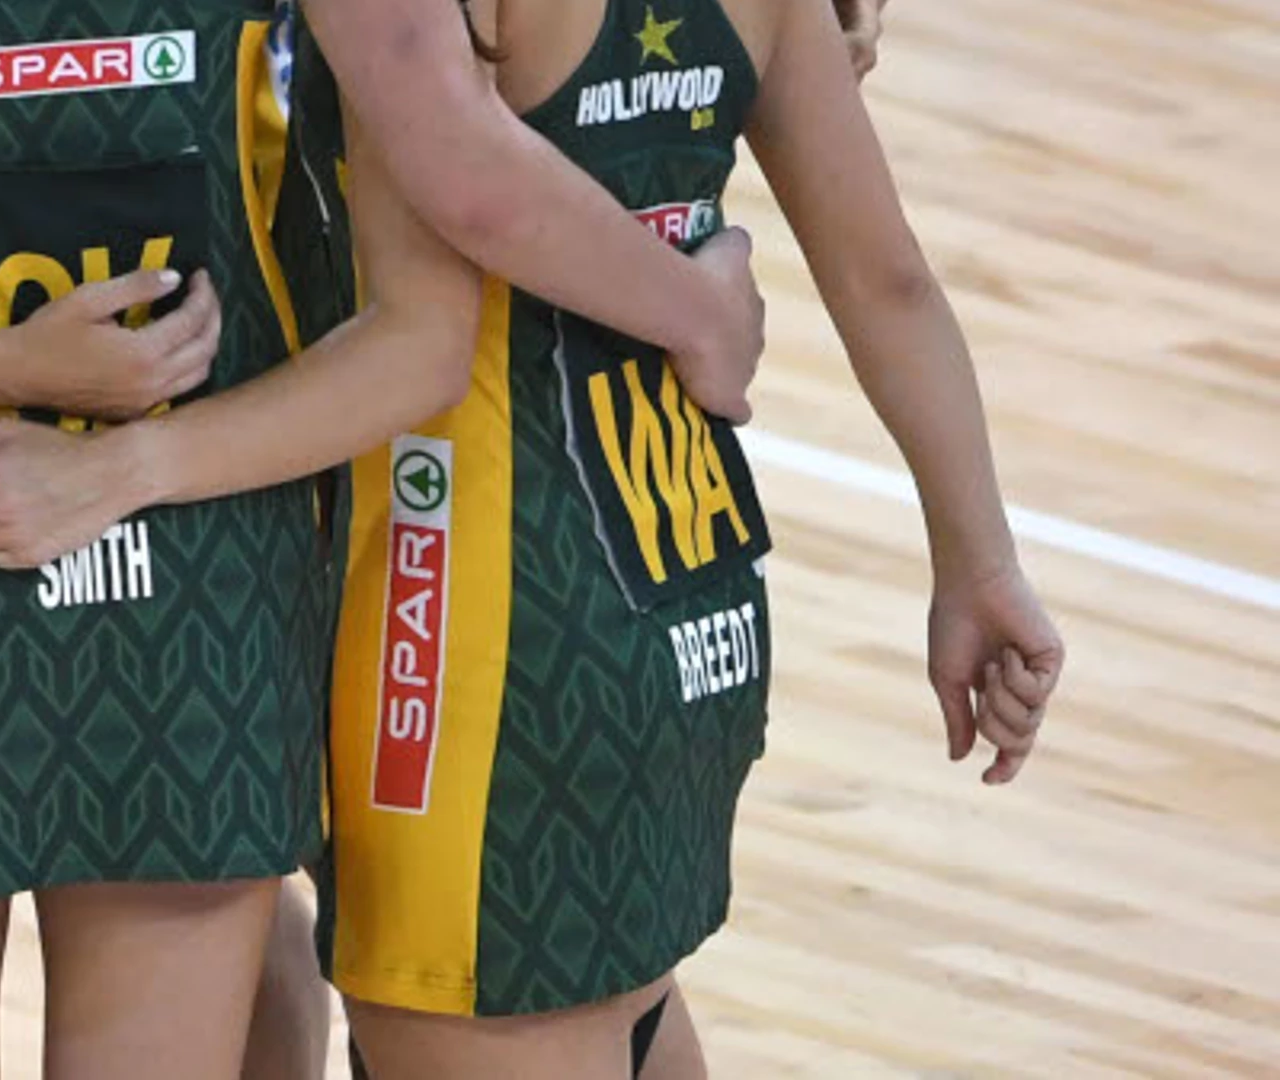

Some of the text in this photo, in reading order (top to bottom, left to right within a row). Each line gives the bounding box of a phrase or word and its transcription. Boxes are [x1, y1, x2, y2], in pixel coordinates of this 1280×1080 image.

[587, 358, 752, 585] WA
[389, 530, 436, 742] SPAR
[669, 602, 759, 703] BREEDT
